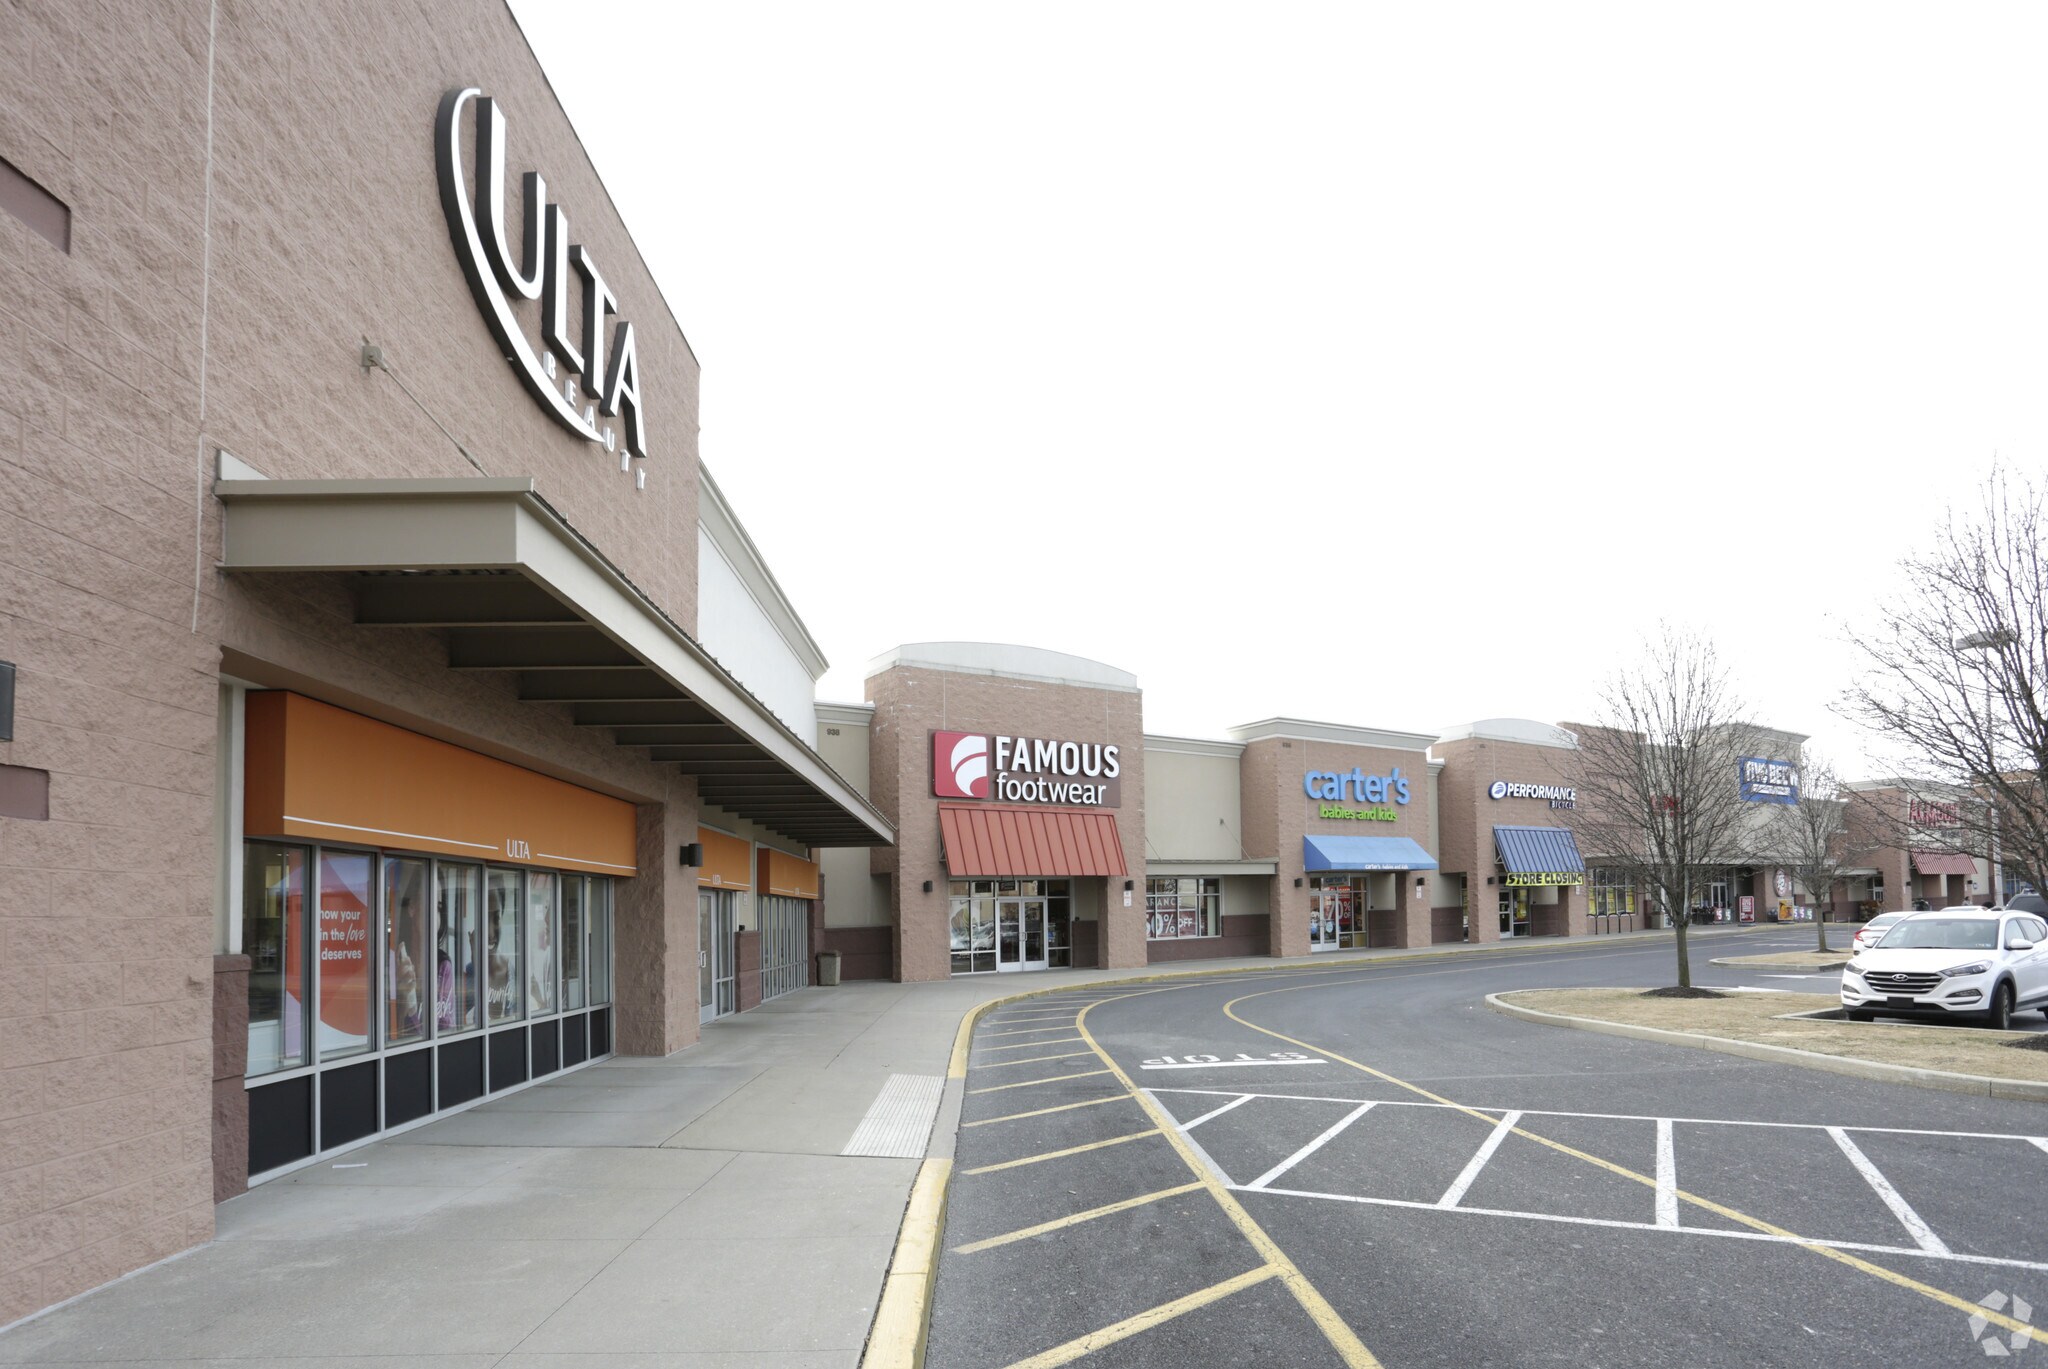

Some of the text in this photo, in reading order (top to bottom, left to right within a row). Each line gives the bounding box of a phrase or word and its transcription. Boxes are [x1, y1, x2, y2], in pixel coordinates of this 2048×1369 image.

[475, 97, 647, 458] ULTA
[543, 352, 647, 489] BEAUTY
[995, 735, 1120, 778] FAMOUS
[996, 772, 1107, 804] footwear
[1303, 767, 1411, 805] carter's
[1507, 783, 1576, 800] PERFORMANCE
[1319, 803, 1397, 822] babies and kids
[1551, 801, 1576, 809] BICYCLE
[507, 839, 531, 859] ULTA
[1508, 873, 1582, 885] STORE CLOSING
[340, 911, 361, 923] your
[331, 928, 345, 941] the
[346, 923, 366, 945] love
[321, 948, 362, 960] deserves
[1142, 1052, 1309, 1064] STOP
